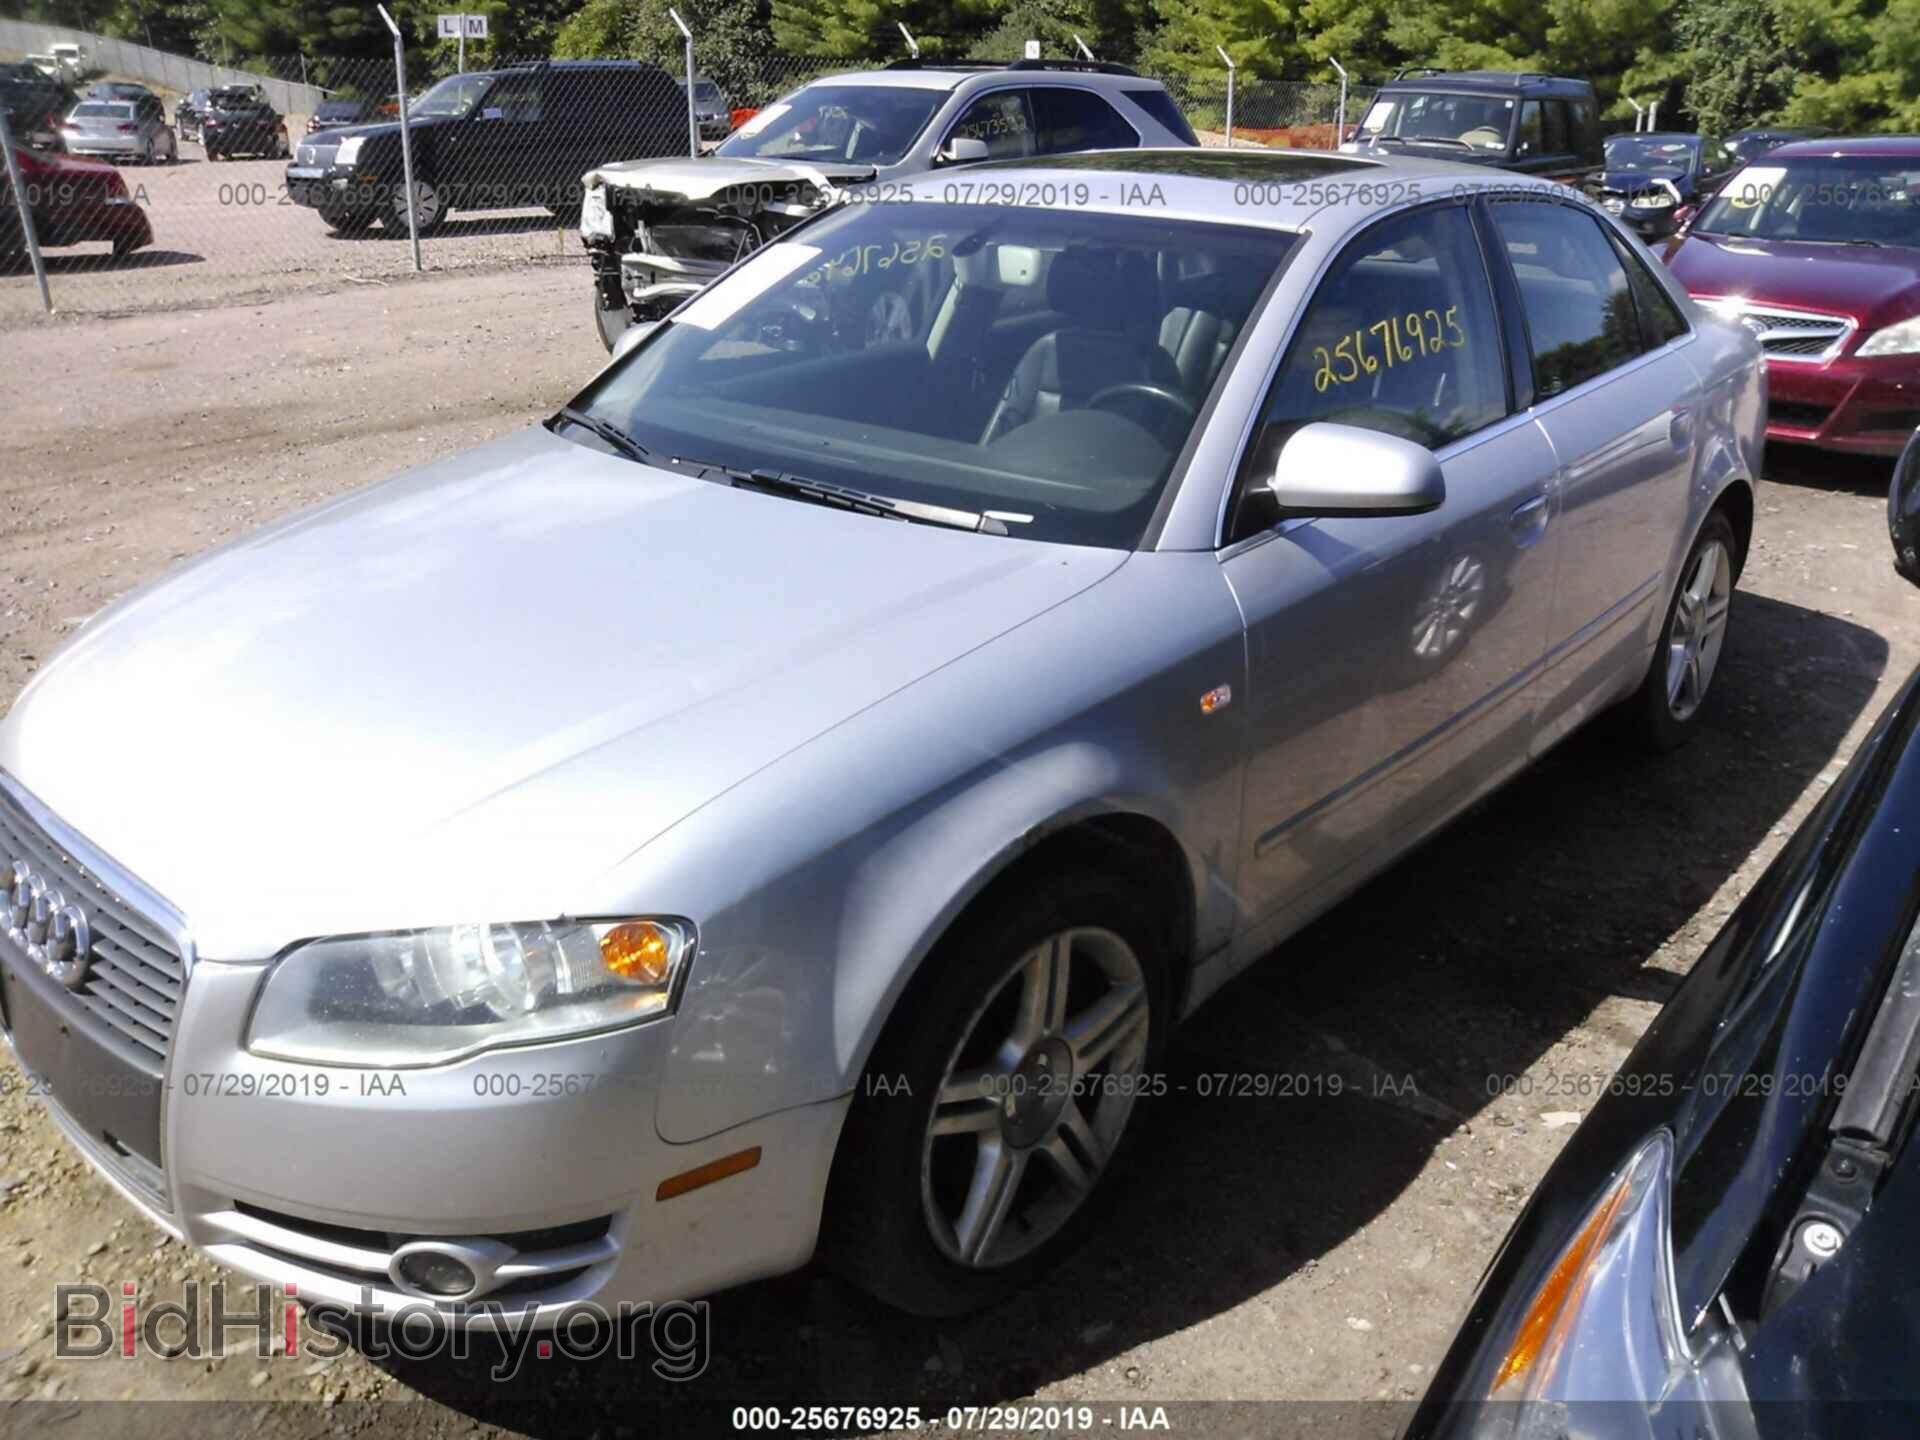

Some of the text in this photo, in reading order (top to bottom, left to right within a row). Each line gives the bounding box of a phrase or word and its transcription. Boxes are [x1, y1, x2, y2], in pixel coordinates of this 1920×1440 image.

[443, 19, 455, 33] L
[469, 20, 483, 33] M
[1313, 304, 1465, 393] 25676925
